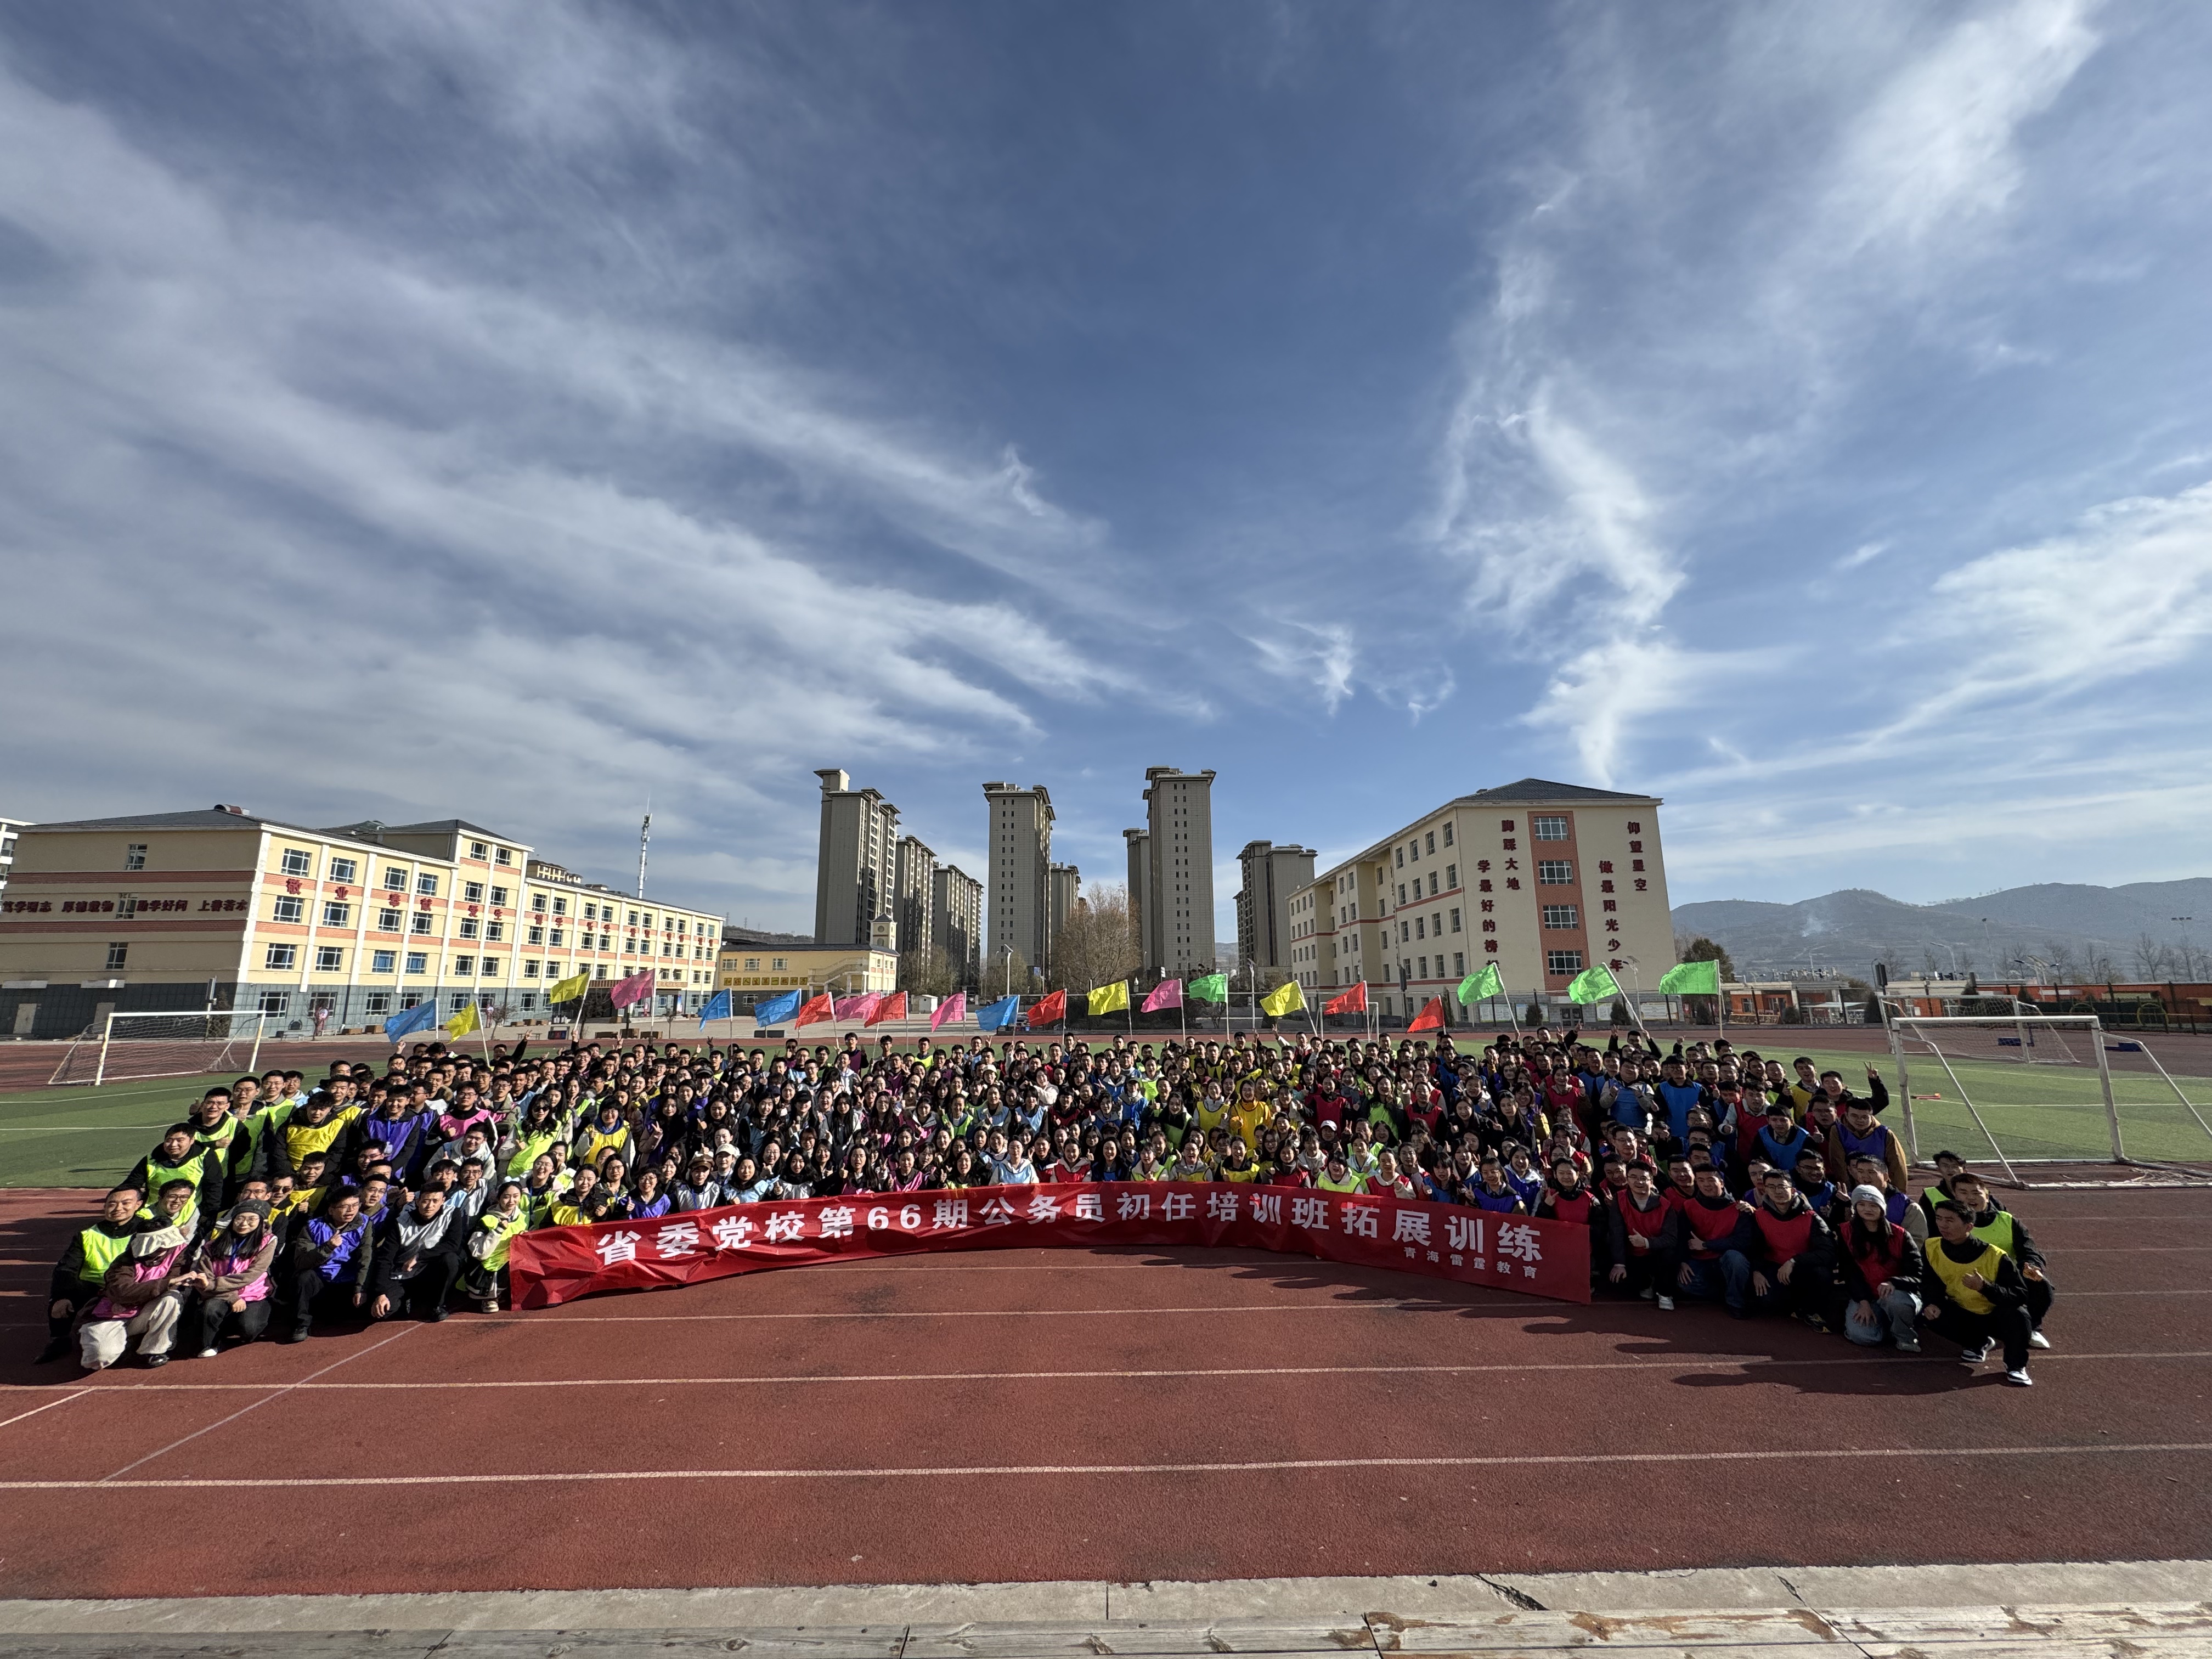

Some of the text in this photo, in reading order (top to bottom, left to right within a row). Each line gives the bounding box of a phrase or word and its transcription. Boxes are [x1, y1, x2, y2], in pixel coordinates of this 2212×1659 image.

[1502, 820, 1520, 890] 脚踩大地
[1627, 821, 1647, 891] 仰望星空
[198, 899, 249, 912] 上善若水
[1599, 860, 1623, 972] 做最阳光少年
[596, 1191, 1543, 1265] 省委党校第66期公务员初任培训班拓展训练
[1403, 1247, 1537, 1279] 青海雷霆教育
